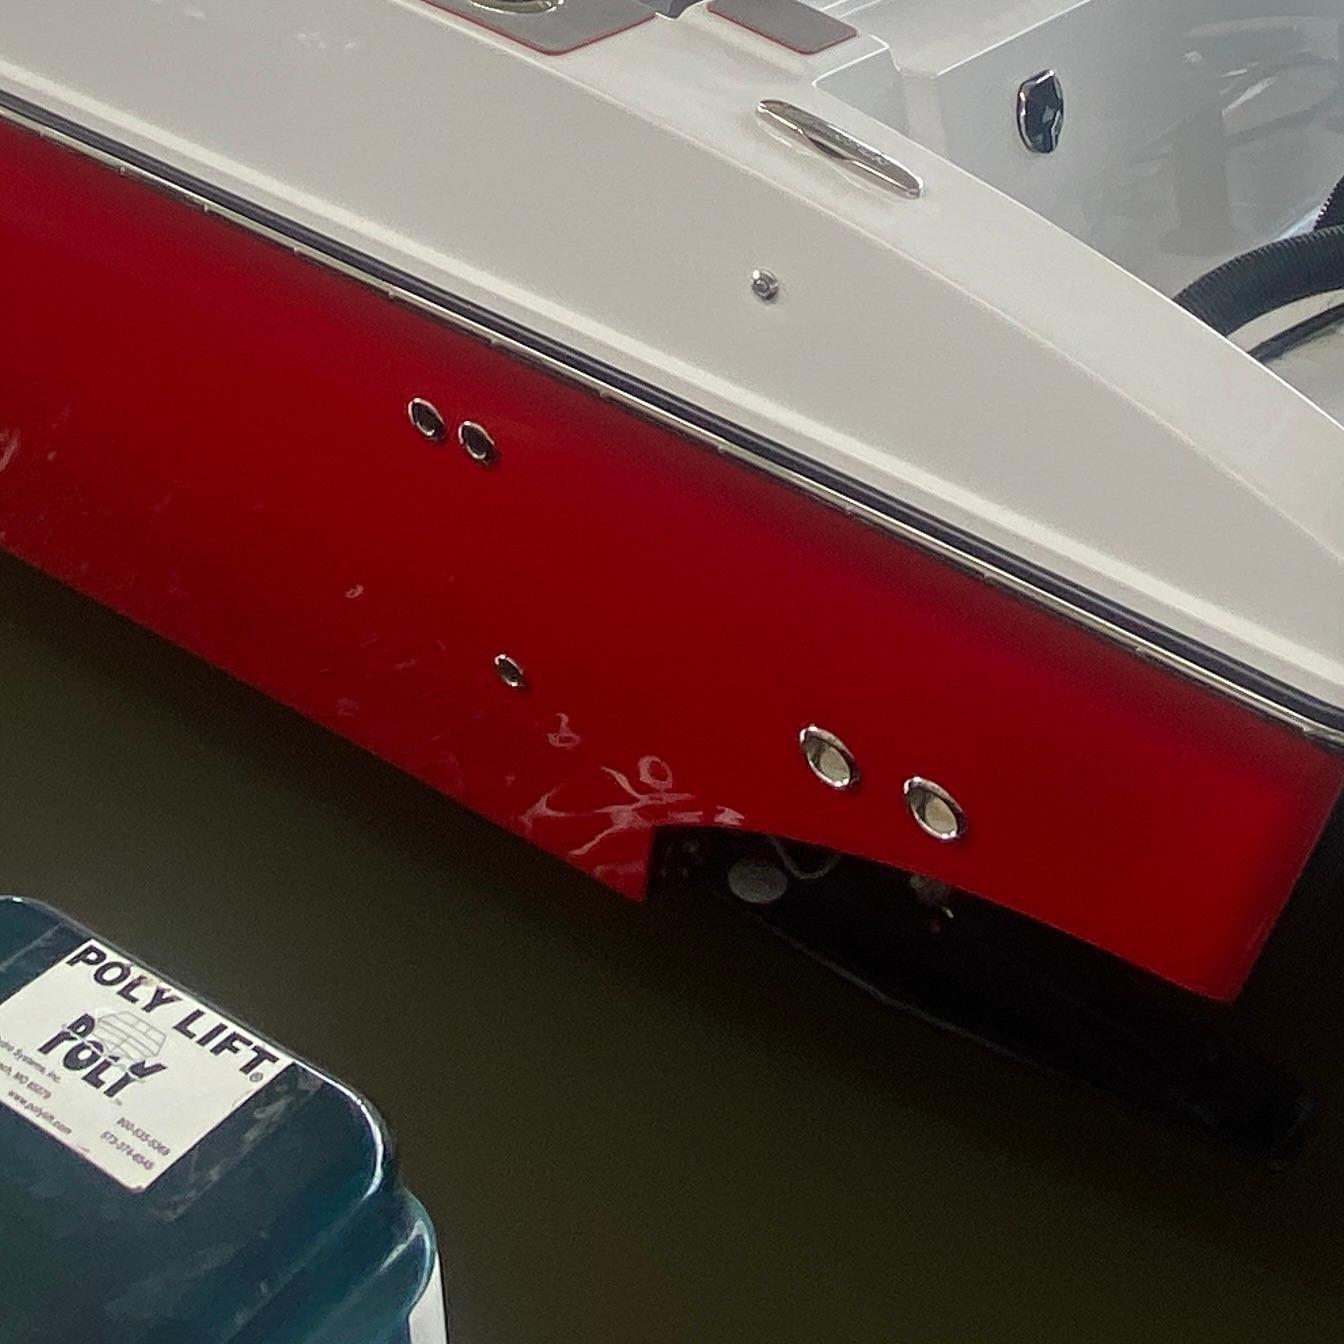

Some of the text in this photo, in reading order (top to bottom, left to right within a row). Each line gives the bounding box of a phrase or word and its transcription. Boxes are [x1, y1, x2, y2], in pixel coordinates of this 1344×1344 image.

[38, 1013, 168, 1098] POLY
[66, 944, 280, 1075] POLY LIFT
